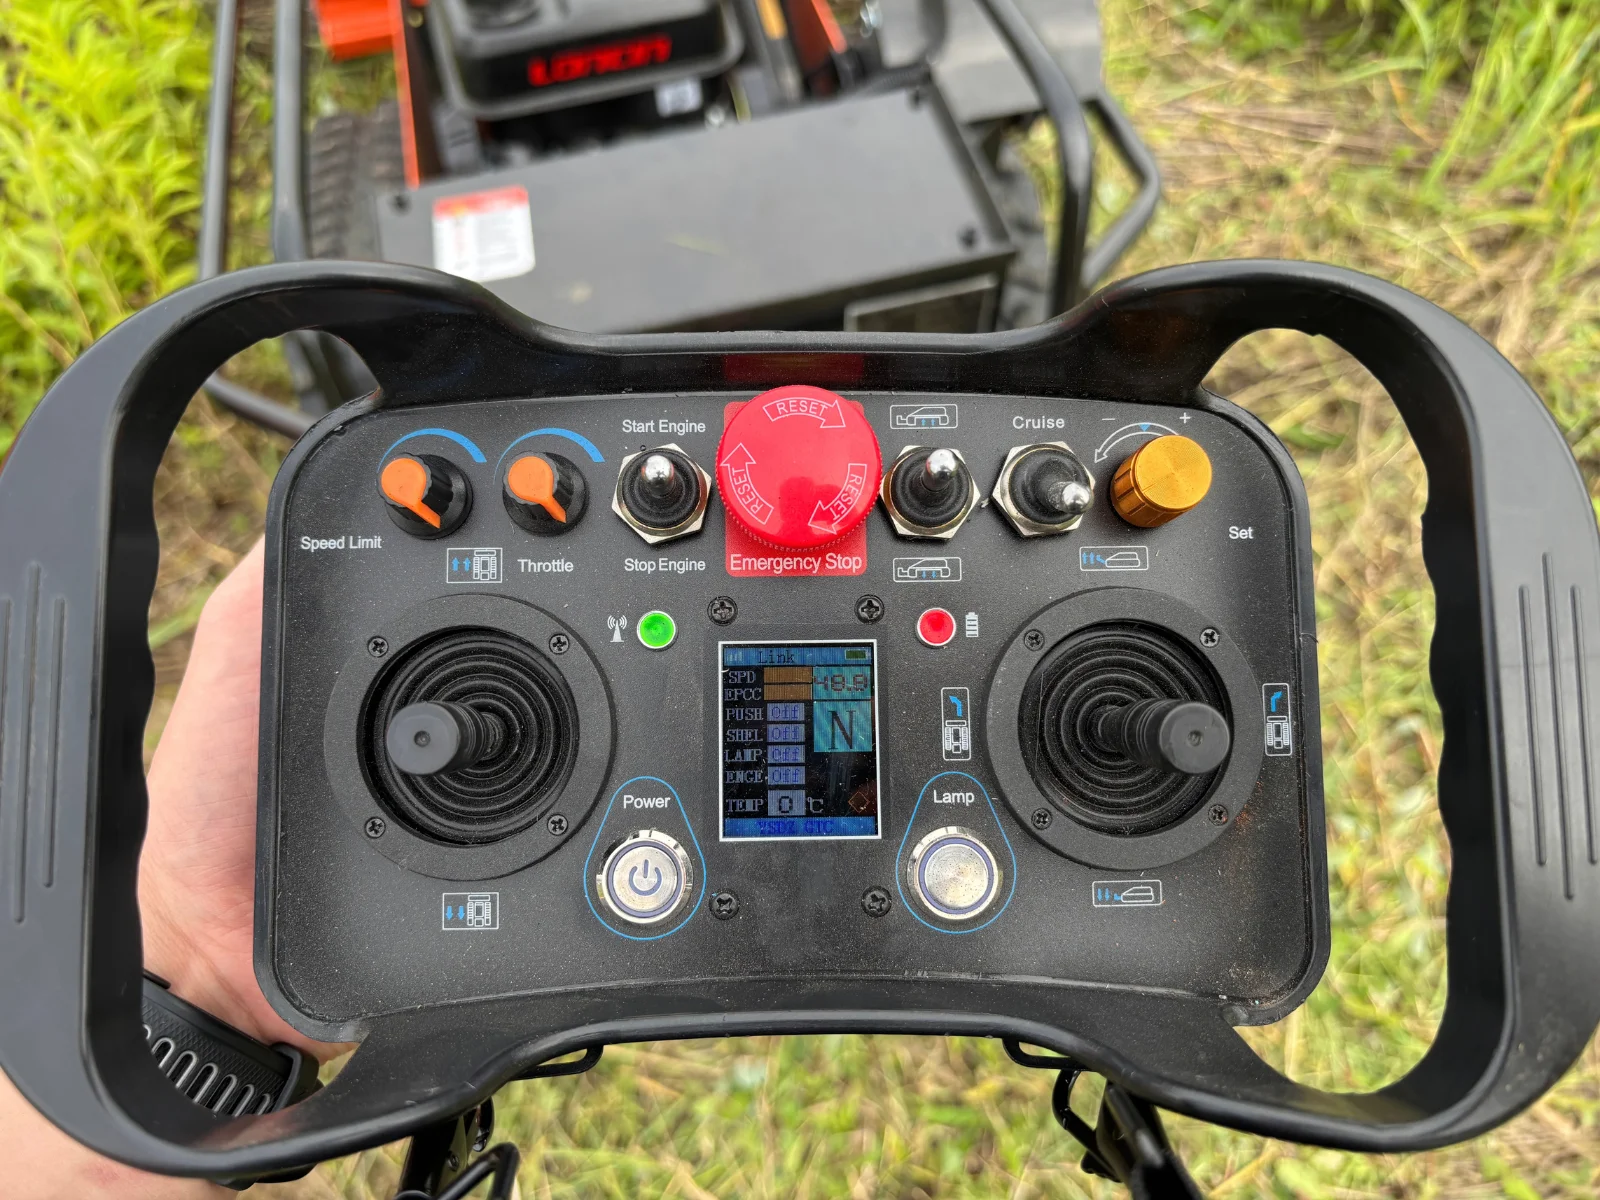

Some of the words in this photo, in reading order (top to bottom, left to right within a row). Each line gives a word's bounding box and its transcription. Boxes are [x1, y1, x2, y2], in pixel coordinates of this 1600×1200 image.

[776, 400, 828, 417] RESET
[622, 419, 656, 433] Start
[658, 419, 706, 435] Engine
[1012, 415, 1065, 429] Cruise
[732, 467, 763, 514] RESET
[832, 473, 862, 520] RESET
[1228, 526, 1253, 540] Set
[301, 536, 346, 551] Speed
[350, 536, 382, 549] Limit
[517, 558, 574, 573] Throttle
[624, 558, 656, 574] Stop
[659, 558, 706, 574] Engine
[730, 553, 821, 574] Emergency
[825, 552, 862, 572] Stop
[758, 650, 794, 664] Link
[728, 670, 756, 684] SPD
[725, 707, 763, 721] PUSH
[771, 707, 799, 720] Off
[726, 729, 763, 742] SHEL
[772, 728, 799, 740] Off
[828, 710, 856, 750] N
[725, 749, 763, 762] LAMP
[772, 749, 799, 761] Off
[772, 769, 800, 782] Off
[623, 795, 671, 809] Power
[726, 799, 764, 812] TEMP
[933, 791, 975, 806] Lamp
